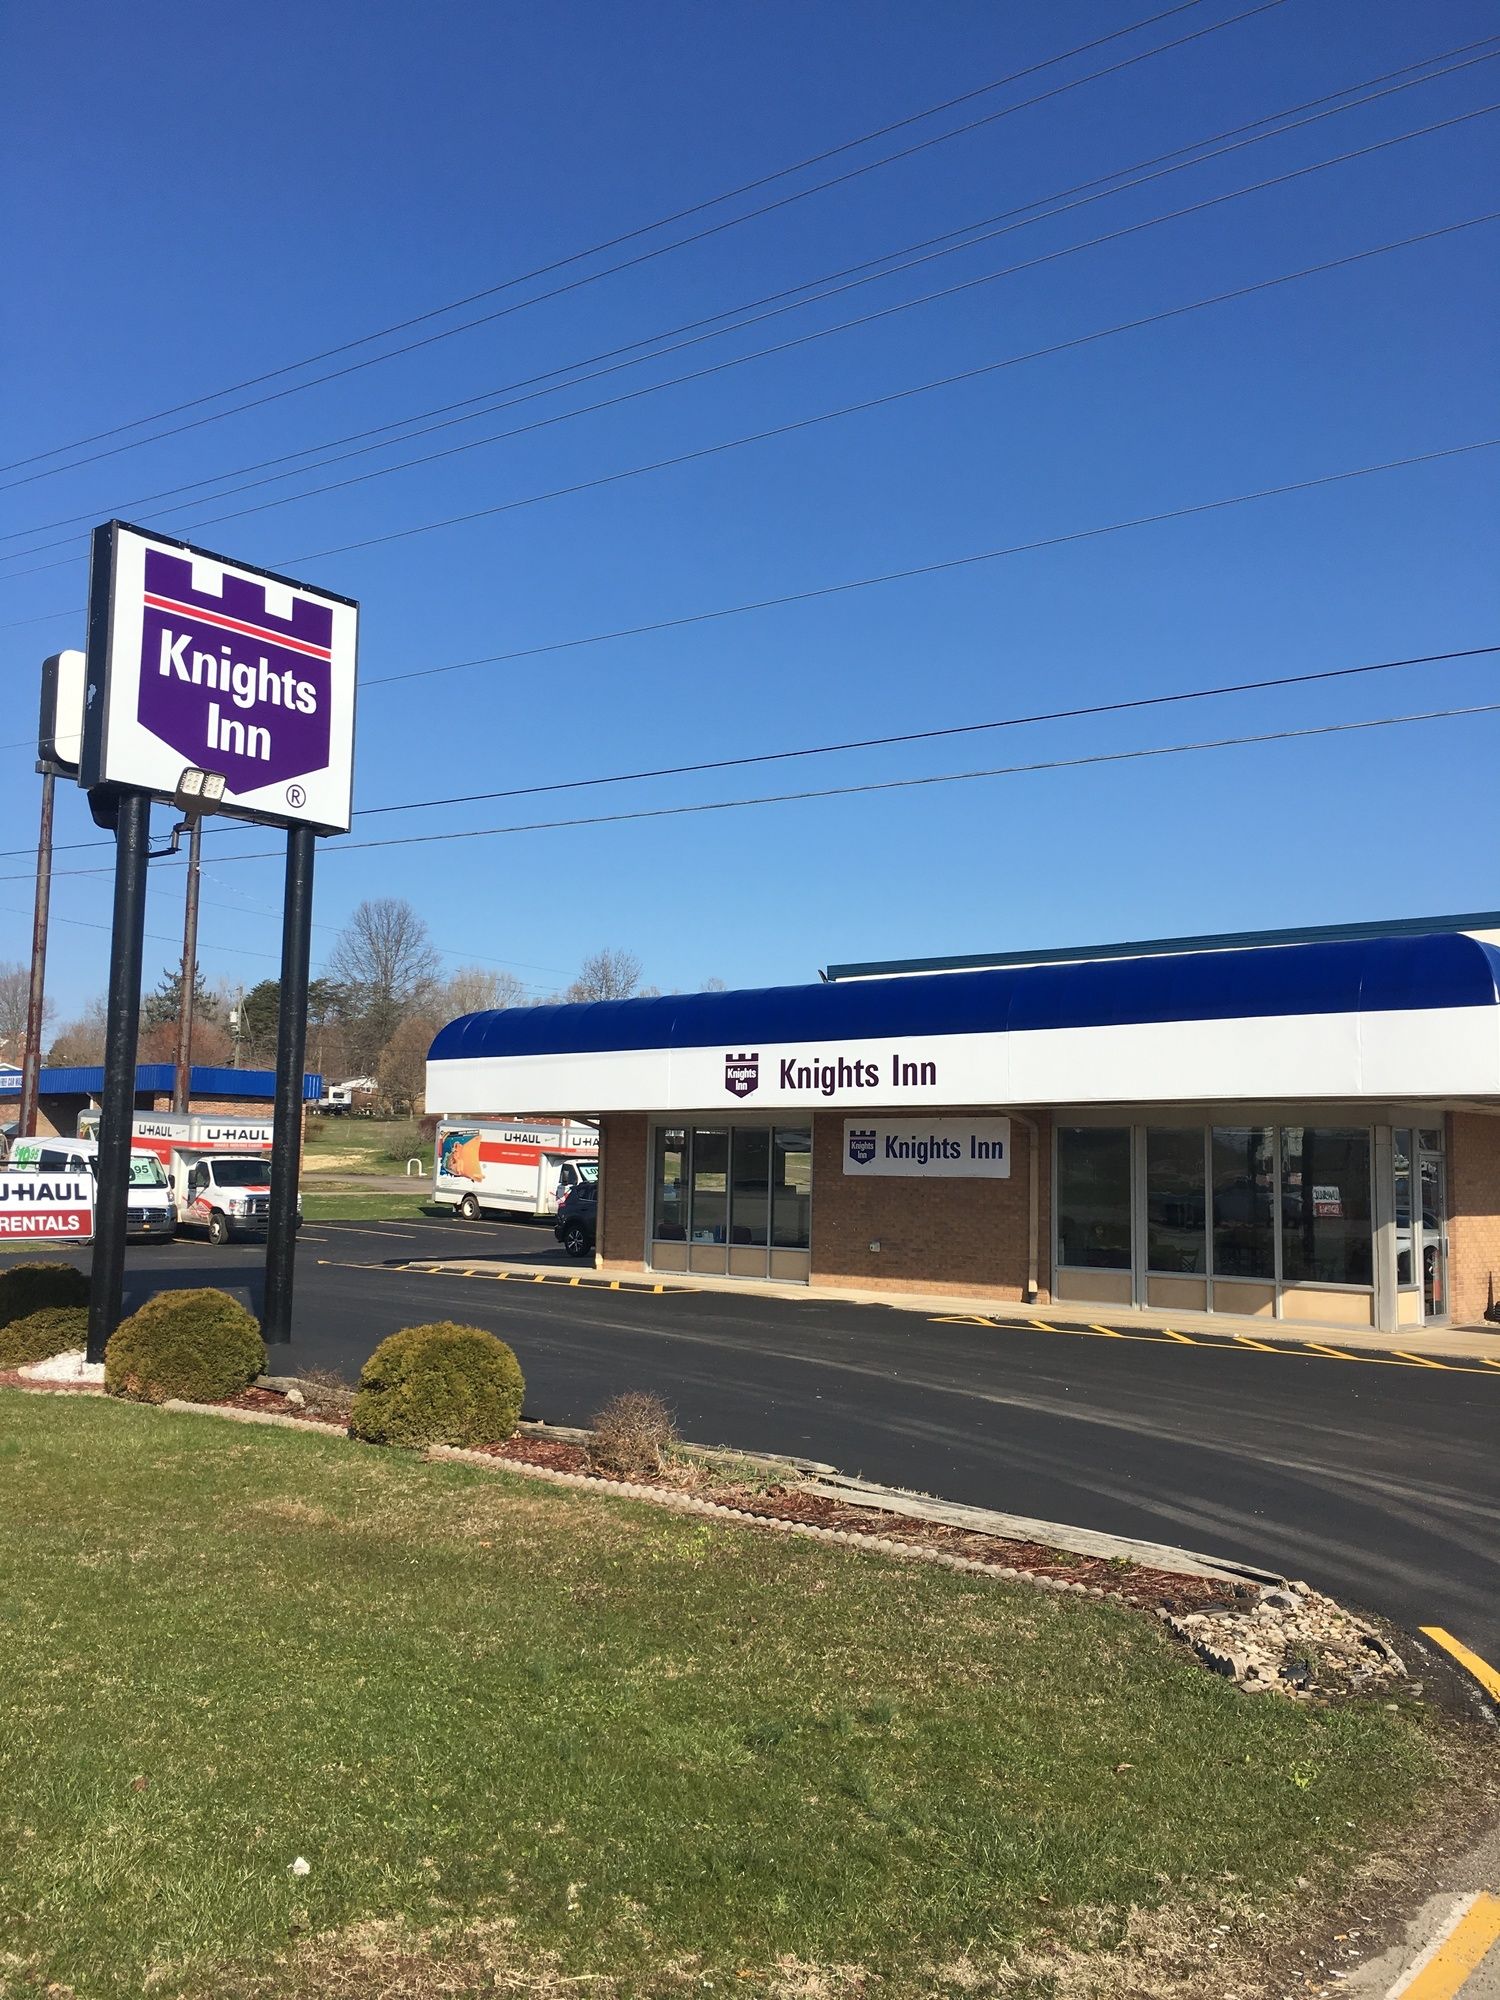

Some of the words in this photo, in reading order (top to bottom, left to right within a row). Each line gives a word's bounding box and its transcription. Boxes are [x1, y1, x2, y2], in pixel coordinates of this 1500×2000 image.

[159, 628, 317, 714] Knights
[207, 702, 271, 761] Inn
[727, 1067, 757, 1081] Knights
[780, 1056, 880, 1097] Knights
[892, 1054, 937, 1087] Inn
[735, 1080, 748, 1091] Inn
[138, 1124, 172, 1137] U-HAUL
[207, 1129, 269, 1140] U-HAUL
[504, 1132, 541, 1144] U-HAUL
[572, 1137, 599, 1147] U-HA
[851, 1141, 874, 1151] Knights
[885, 1135, 961, 1165] Knights
[970, 1135, 1003, 1159] Inn
[857, 1150, 868, 1159] Inn
[0, 1215, 80, 1232] RENTALS
